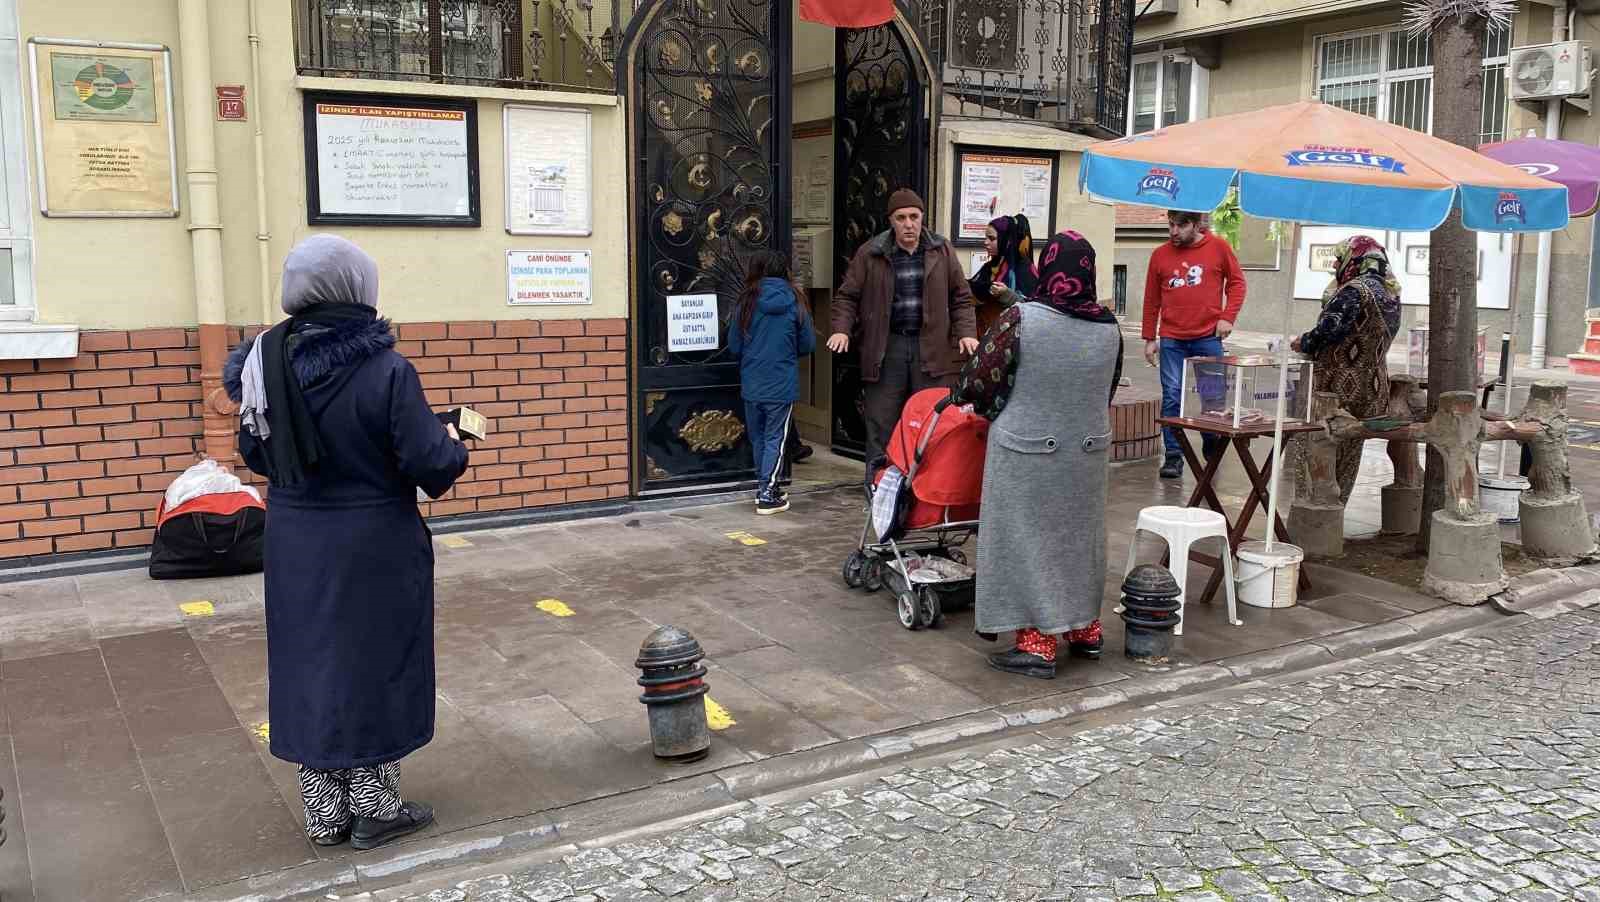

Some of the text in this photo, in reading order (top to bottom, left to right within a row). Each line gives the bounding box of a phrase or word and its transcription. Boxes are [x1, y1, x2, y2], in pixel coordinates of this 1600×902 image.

[226, 102, 239, 111] 17
[321, 105, 462, 120] İZİNSİZ İLAN YAPIŞTIRILAMAZ
[327, 135, 353, 145] 2025
[1297, 151, 1386, 167] Golf
[1142, 176, 1176, 190] Golf
[1498, 200, 1521, 215] Golf
[535, 266, 553, 274] PARA
